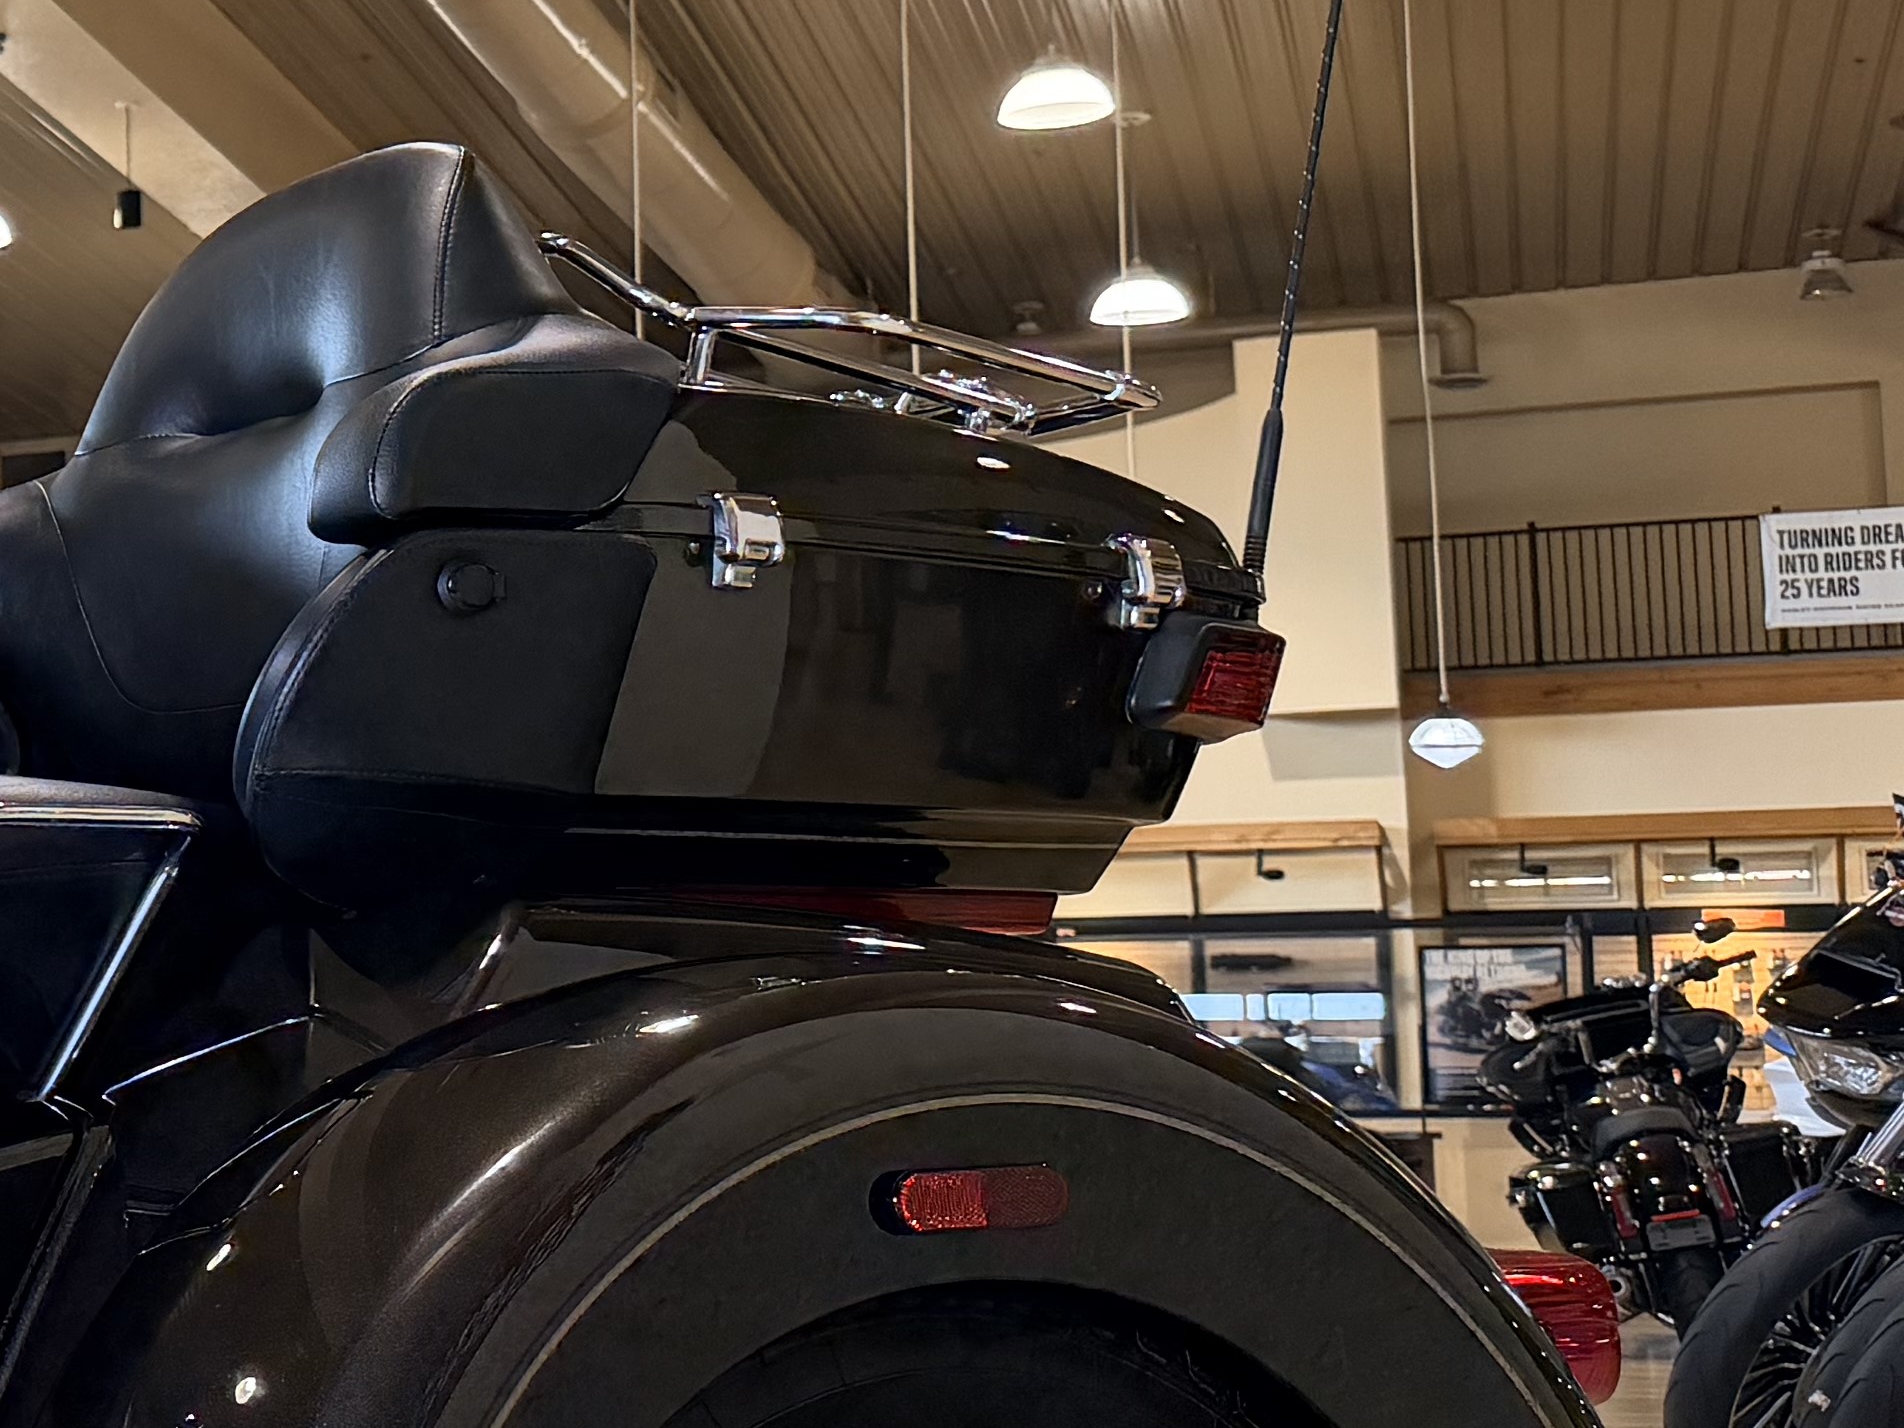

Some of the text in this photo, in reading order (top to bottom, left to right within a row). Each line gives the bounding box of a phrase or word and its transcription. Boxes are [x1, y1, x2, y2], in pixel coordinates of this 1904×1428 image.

[1776, 525, 1856, 551] TURNING
[1778, 553, 1819, 575] INTO
[1824, 549, 1887, 574] RIDERS
[1779, 575, 1861, 600] 25 YEARS
